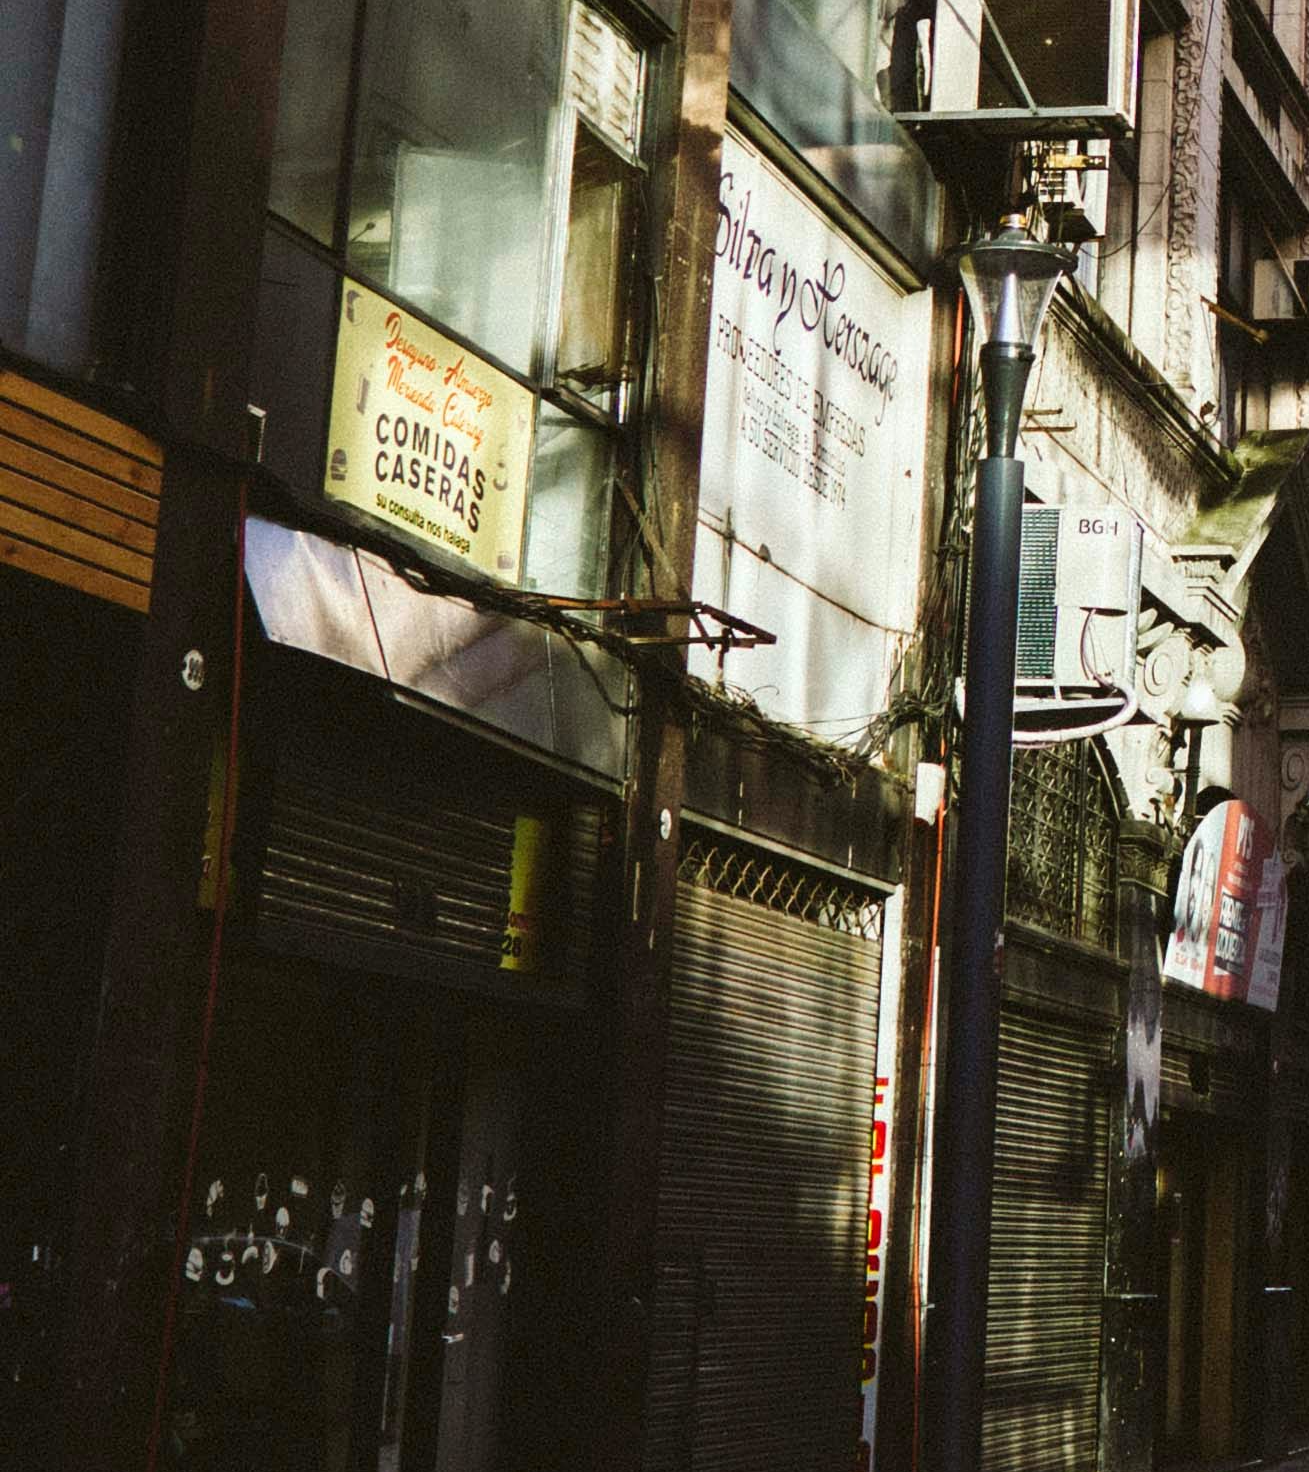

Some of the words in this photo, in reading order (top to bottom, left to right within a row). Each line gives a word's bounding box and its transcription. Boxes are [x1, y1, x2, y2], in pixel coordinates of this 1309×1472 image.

[773, 261, 797, 356] y
[386, 355, 435, 415] Merienda
[443, 355, 494, 412] Almuerzo
[375, 413, 487, 502] COMIDAS
[374, 450, 480, 534] CASERAS
[375, 492, 387, 509] su
[388, 499, 425, 530] consulta
[426, 519, 442, 539] nos
[1079, 518, 1118, 536] BGH
